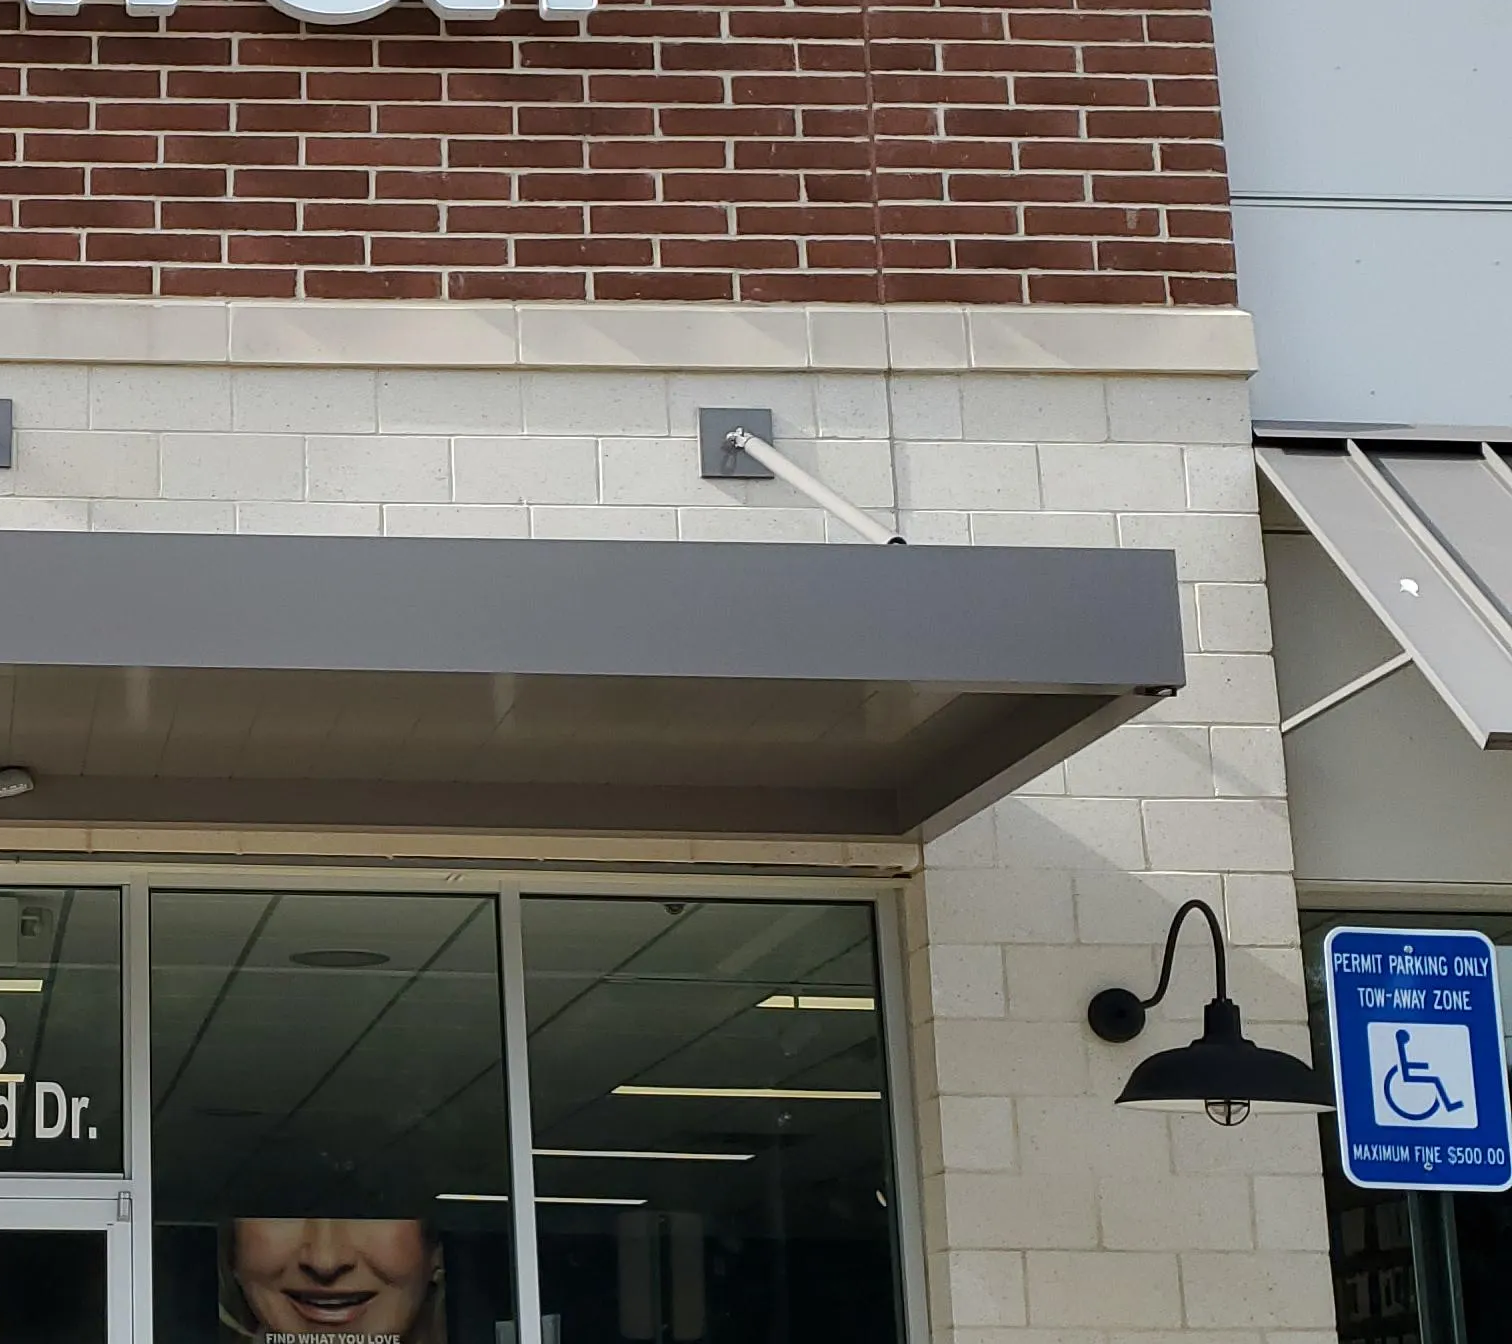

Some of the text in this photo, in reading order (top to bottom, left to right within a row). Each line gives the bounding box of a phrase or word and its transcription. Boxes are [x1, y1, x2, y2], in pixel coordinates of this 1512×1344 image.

[1333, 952, 1489, 977] PERMIT PARKING ONLY
[1357, 987, 1473, 1011] TOW-AWAY ZONE
[35, 1081, 98, 1139] Dr.
[1353, 1143, 1505, 1166] MAXIMUM FINE $500.00
[266, 1333, 296, 1344] FIND
[298, 1333, 336, 1344] WHAT
